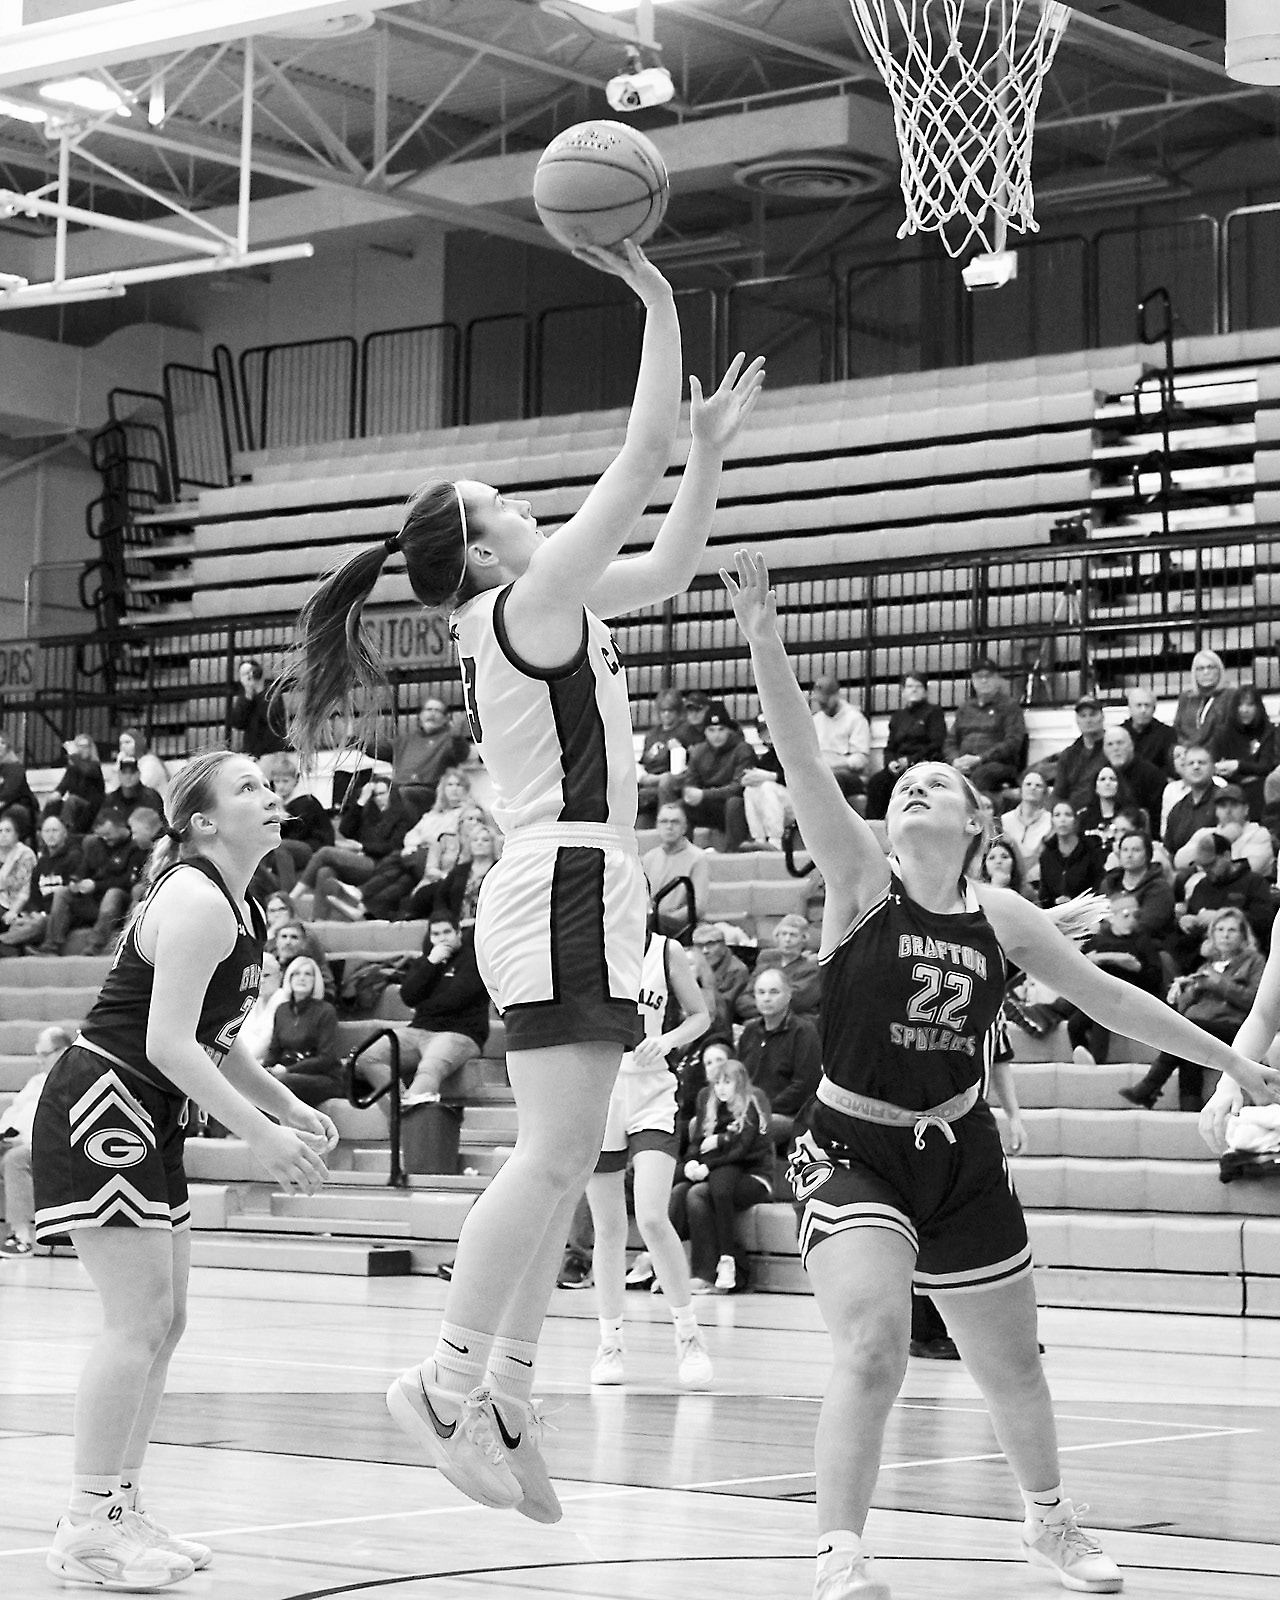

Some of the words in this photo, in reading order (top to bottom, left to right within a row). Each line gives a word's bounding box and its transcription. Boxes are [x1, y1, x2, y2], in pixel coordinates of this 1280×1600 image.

[899, 934, 987, 980] GRAFTON
[906, 963, 973, 1031] 22
[84, 1128, 147, 1168] G
